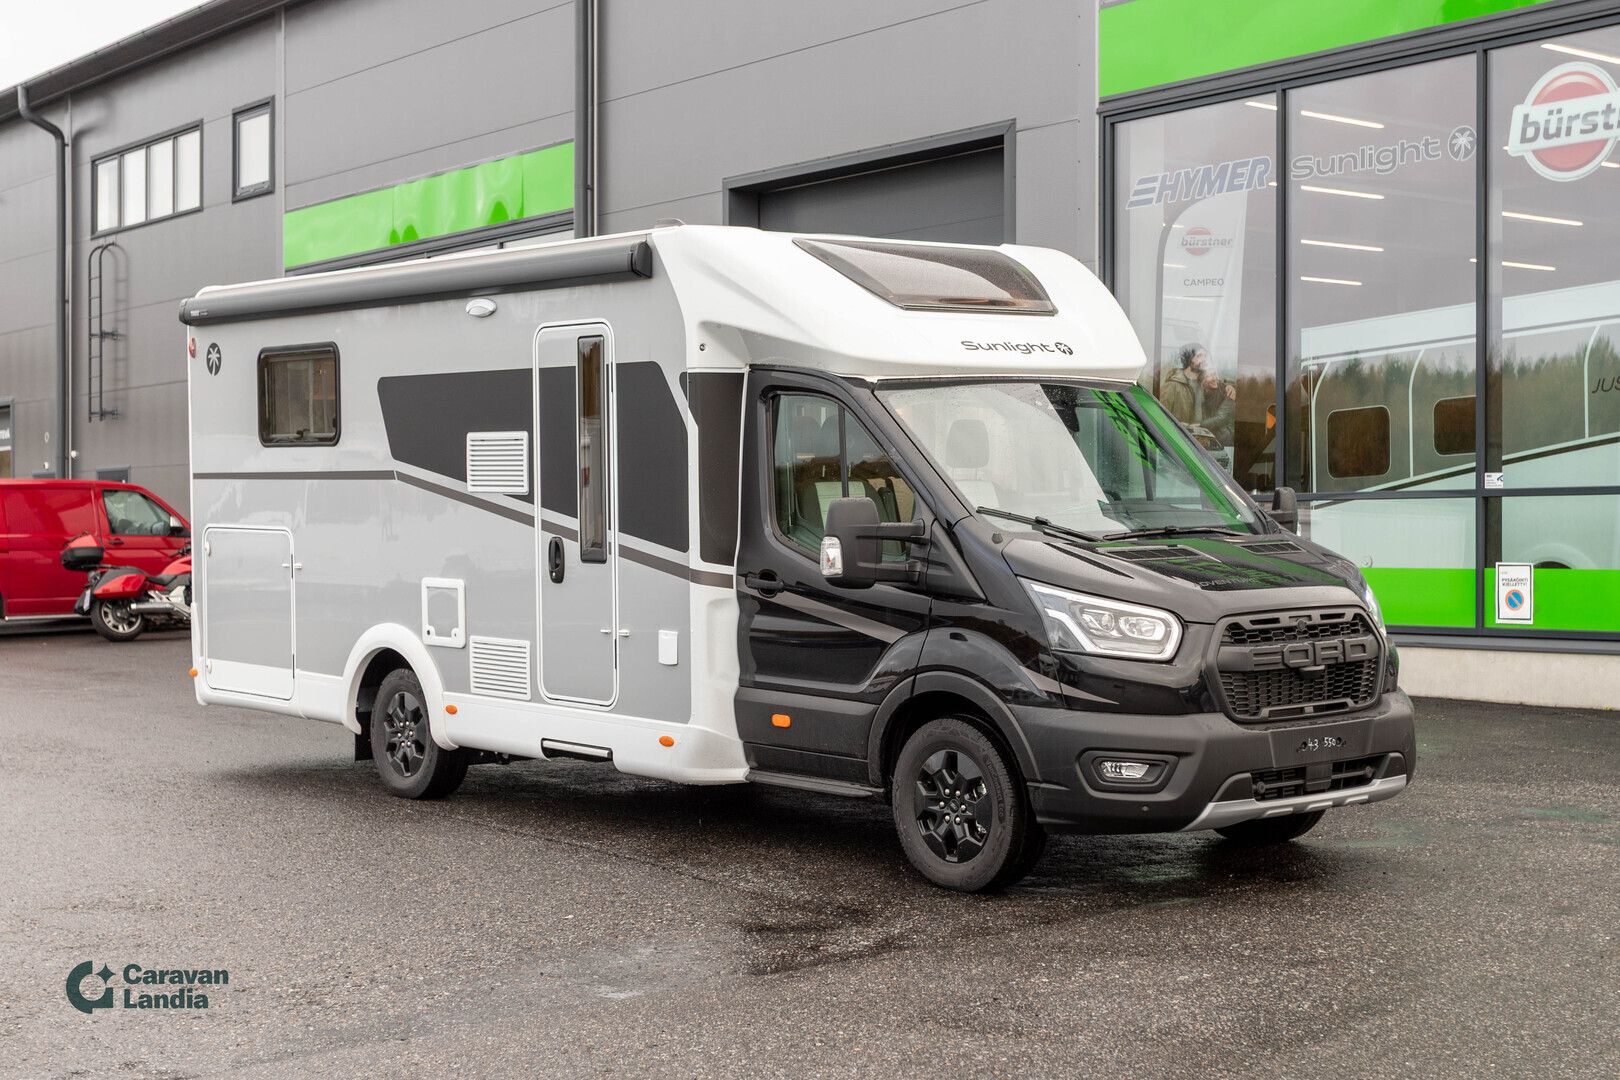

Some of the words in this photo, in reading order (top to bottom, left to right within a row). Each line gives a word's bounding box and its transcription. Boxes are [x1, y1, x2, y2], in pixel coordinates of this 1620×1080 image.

[1519, 103, 1620, 145] bürst
[1290, 136, 1442, 181] Sunlight
[1153, 155, 1272, 206] HYMER
[1181, 236, 1233, 247] bürstner
[1183, 278, 1225, 287] CAMPEO
[960, 340, 1055, 355] Sunlight
[1250, 639, 1371, 672] FORD
